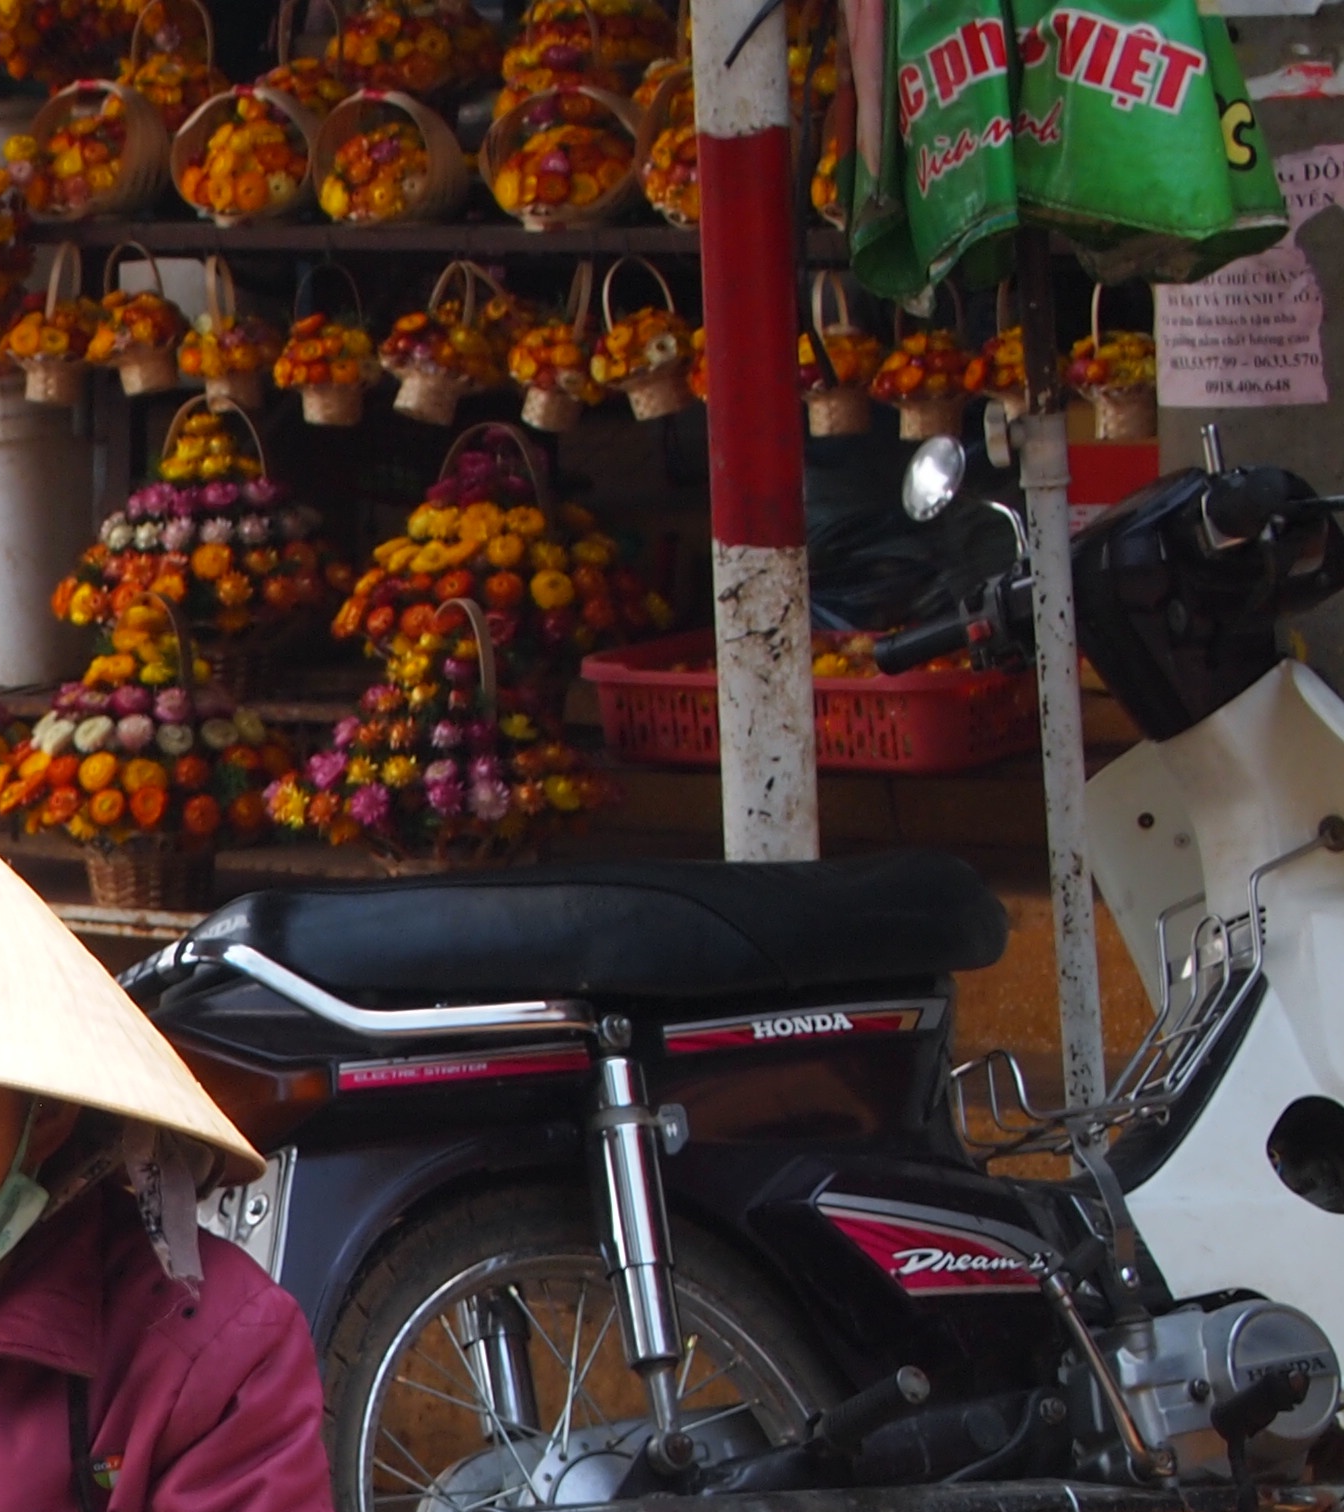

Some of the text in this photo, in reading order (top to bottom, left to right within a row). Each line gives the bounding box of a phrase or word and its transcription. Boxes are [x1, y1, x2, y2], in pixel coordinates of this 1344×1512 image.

[1052, 12, 1203, 109] VIỆT
[752, 1012, 853, 1040] HONDA
[890, 1248, 1024, 1275] Dream
